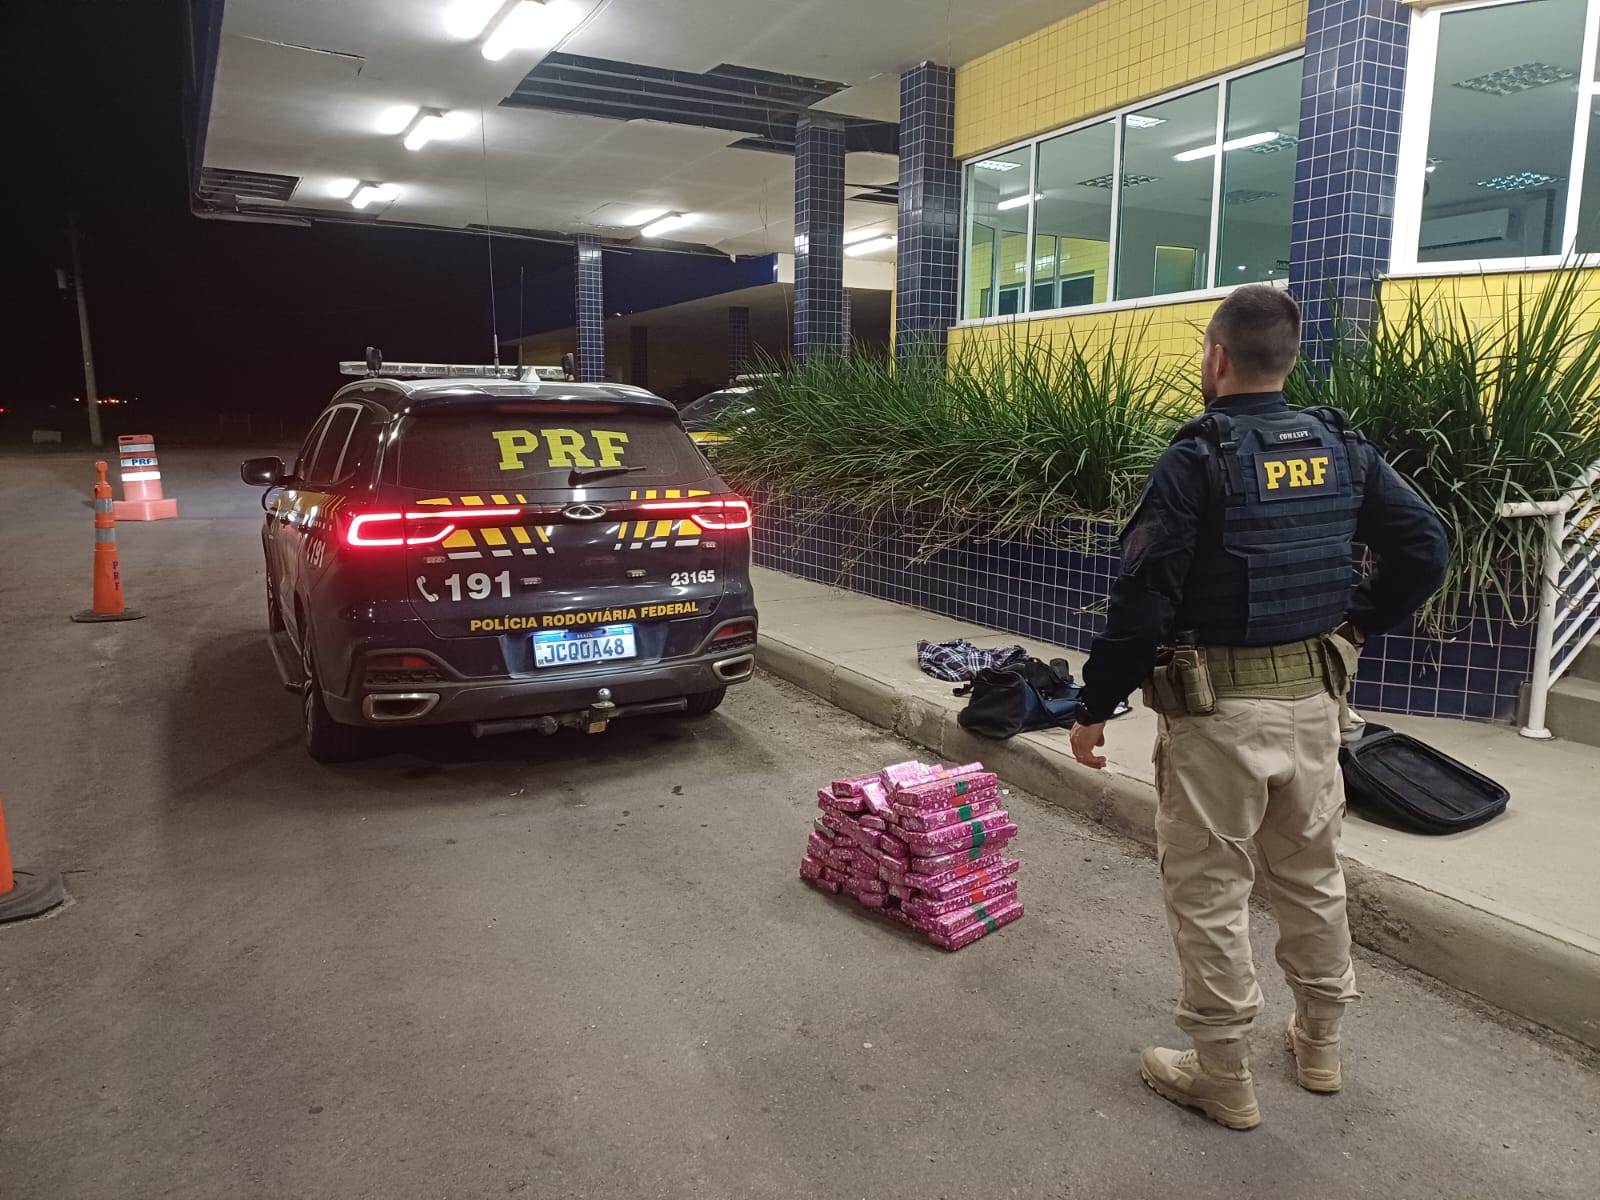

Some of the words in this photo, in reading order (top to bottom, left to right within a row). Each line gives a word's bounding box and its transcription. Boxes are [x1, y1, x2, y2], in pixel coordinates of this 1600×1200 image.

[131, 458, 153, 466] PRF
[492, 428, 629, 470] PRF
[1263, 456, 1329, 490] PRF
[310, 539, 326, 568] 191
[444, 570, 512, 602] 191
[670, 569, 716, 586] 23165
[470, 615, 538, 632] POLÍCIA
[542, 608, 637, 628] RODOVIÁRIA
[640, 601, 699, 618] FEDERAL
[544, 637, 625, 663] JCQ0A48
